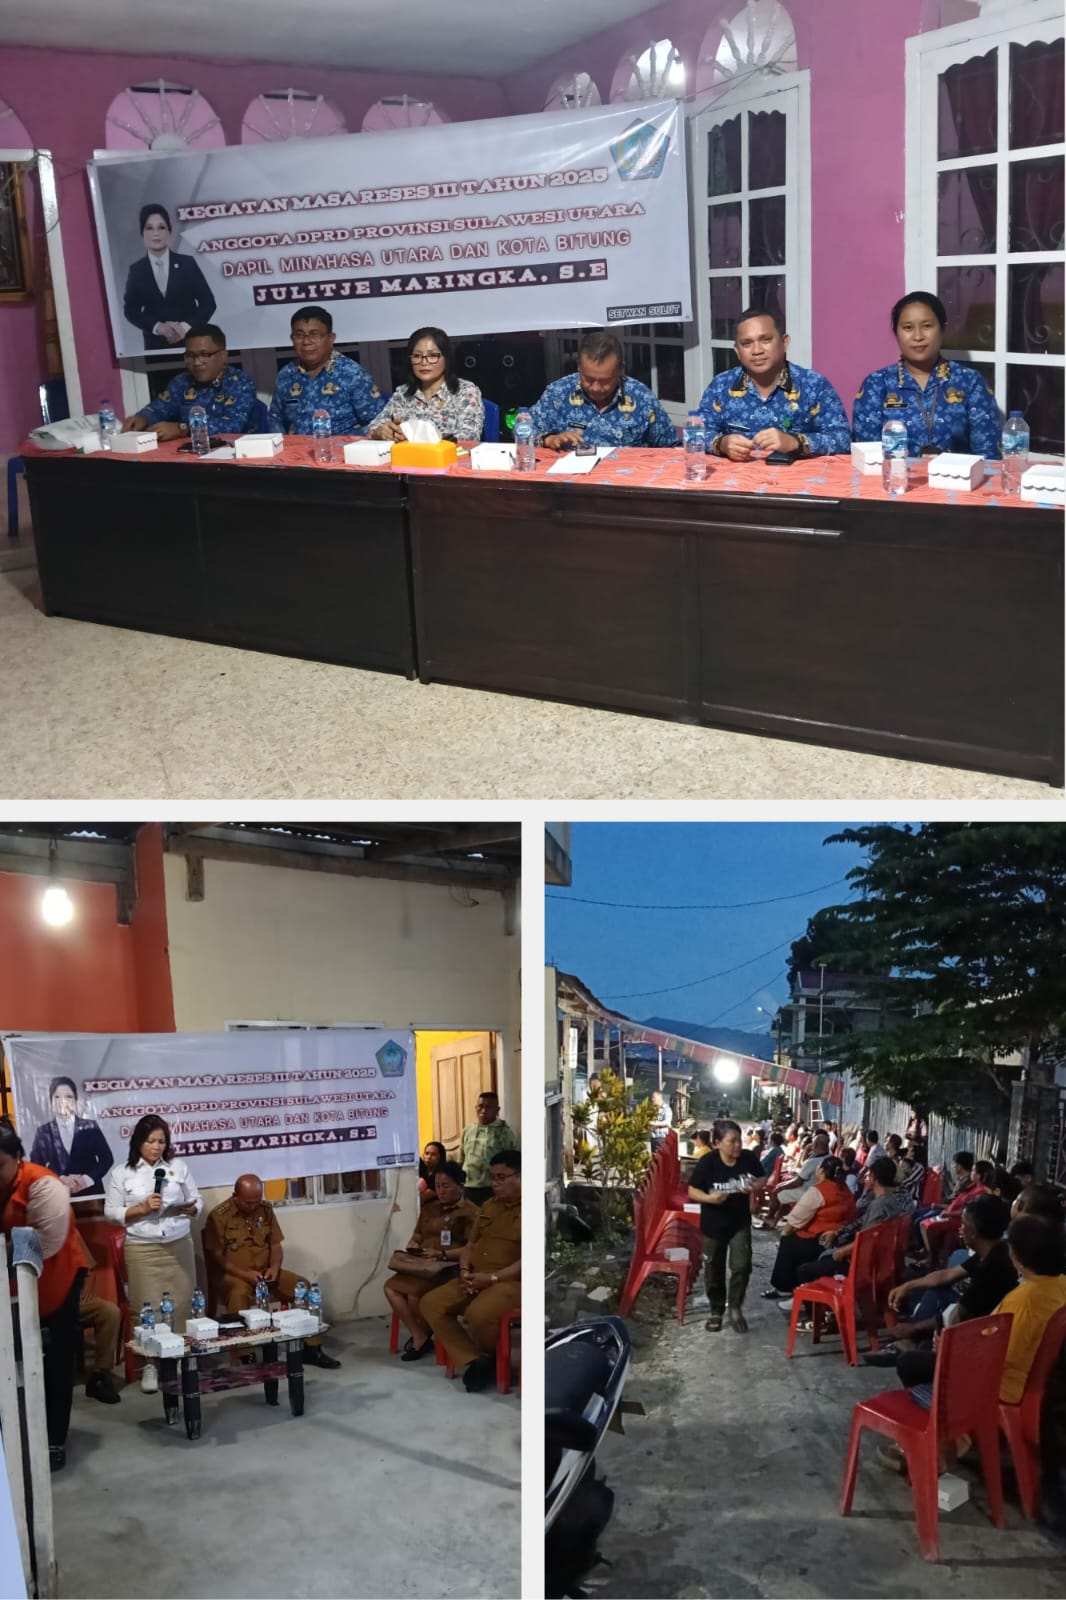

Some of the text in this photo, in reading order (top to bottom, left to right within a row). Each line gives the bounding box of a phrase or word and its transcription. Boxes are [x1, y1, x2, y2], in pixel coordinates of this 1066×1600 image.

[177, 168, 609, 221] KEGIATAN MASA RESES III TAHUN 2025
[198, 202, 646, 252] ANGGOTA DPRD PROVINSI SULAWESI UTARA
[223, 229, 631, 278] DAPIL MINAHASA UTARA DAN KOTA BITUNG
[255, 280, 371, 302] JULITJE
[559, 262, 607, 280] S.E
[608, 305, 681, 319] SETWAN SULUT
[84, 1067, 376, 1092] KEGIATAN MASA RESES III TAHUN 2025
[101, 1090, 396, 1118] ANGGOTA DPRD PROVINSI SULAWESI UTARA
[240, 1115, 280, 1128] UTARA
[284, 1113, 309, 1125] DAN
[313, 1110, 345, 1122] KOTA
[347, 1106, 389, 1120] BITUNG
[172, 1140, 233, 1154] LITJE
[350, 1127, 376, 1139] S.E
